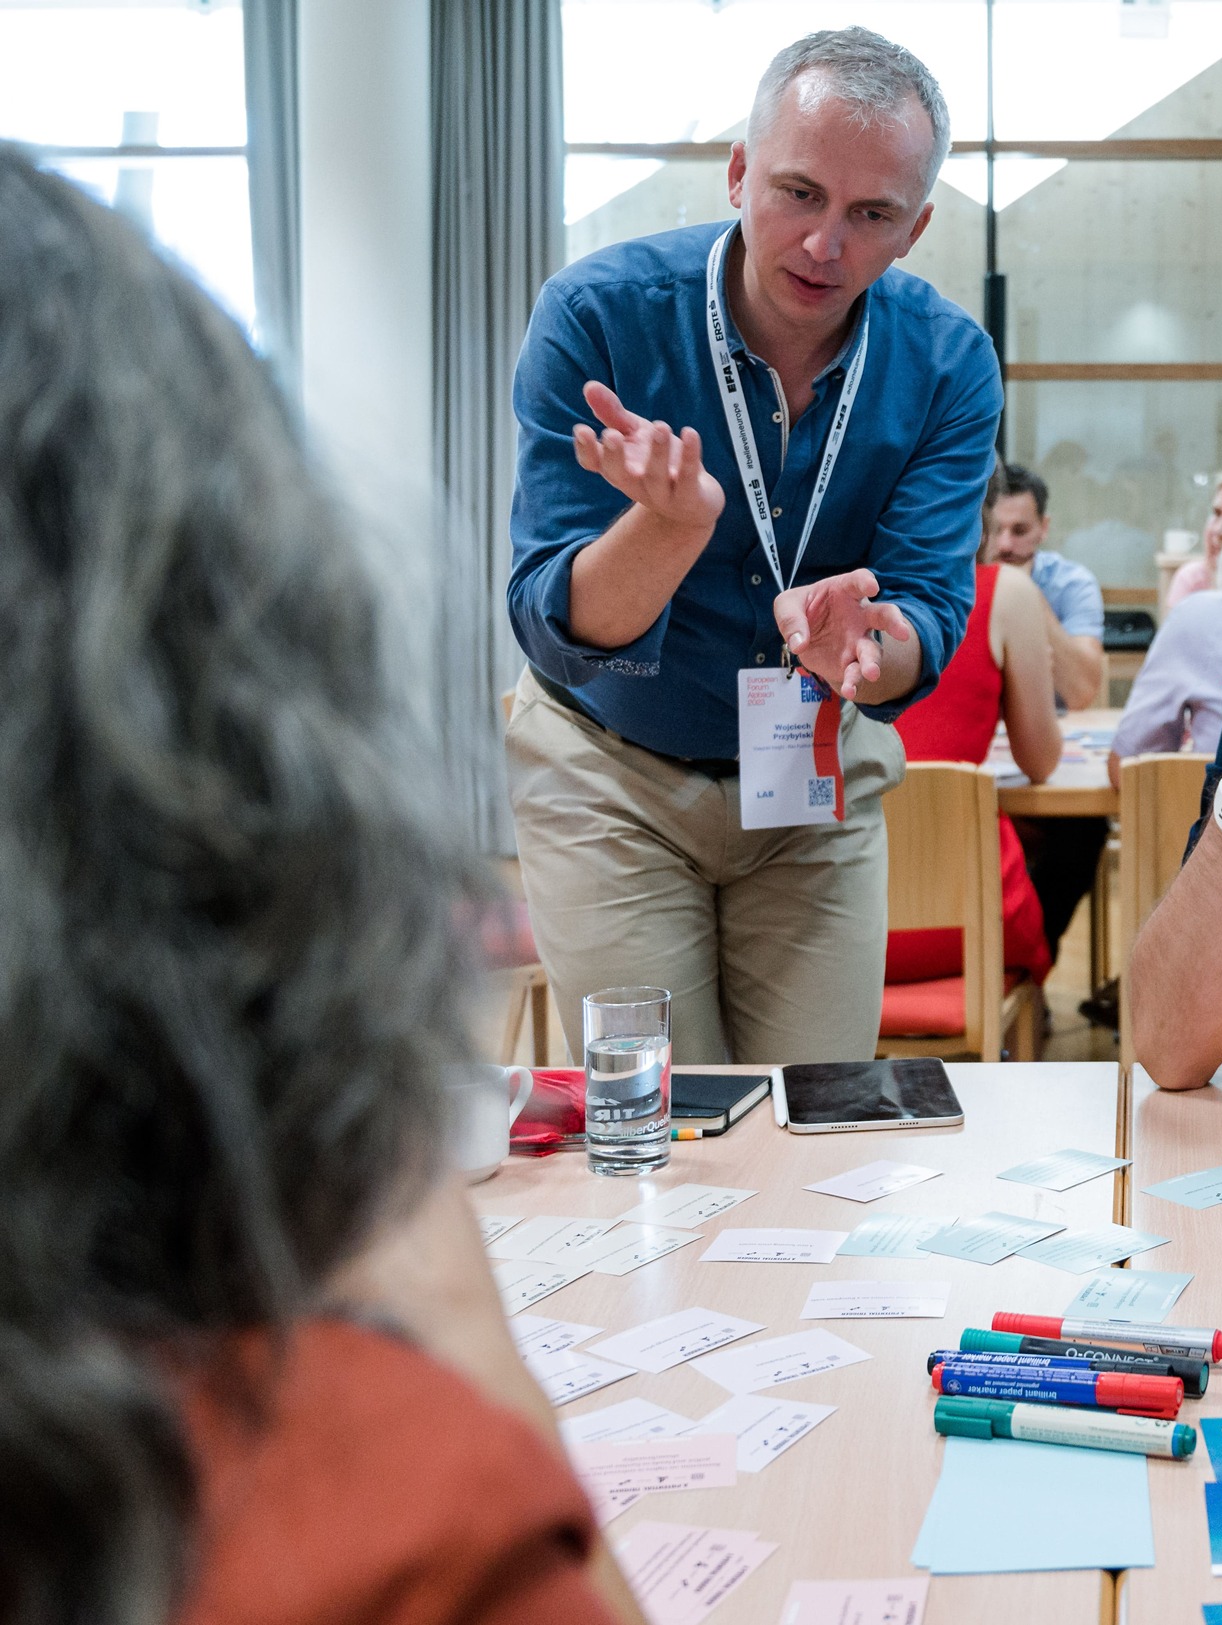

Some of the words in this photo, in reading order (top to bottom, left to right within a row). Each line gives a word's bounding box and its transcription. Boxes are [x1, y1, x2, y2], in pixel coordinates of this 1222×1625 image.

[711, 310, 724, 342] ERSTE
[722, 364, 738, 394] EFA
[835, 404, 848, 431] EFA
[733, 402, 754, 470] #believeineurope
[819, 453, 833, 483] ERSTE
[754, 489, 768, 521] ERSTE
[775, 723, 812, 733] Wojciech
[756, 790, 775, 799] LAB
[619, 1113, 671, 1137] ilberQuelle
[961, 1352, 992, 1364] marker
[992, 1354, 1019, 1366] paper
[1019, 1356, 1051, 1367] brilliant
[967, 1384, 997, 1396] marker
[999, 1385, 1023, 1397] paper
[1025, 1388, 1057, 1400] brilliant
